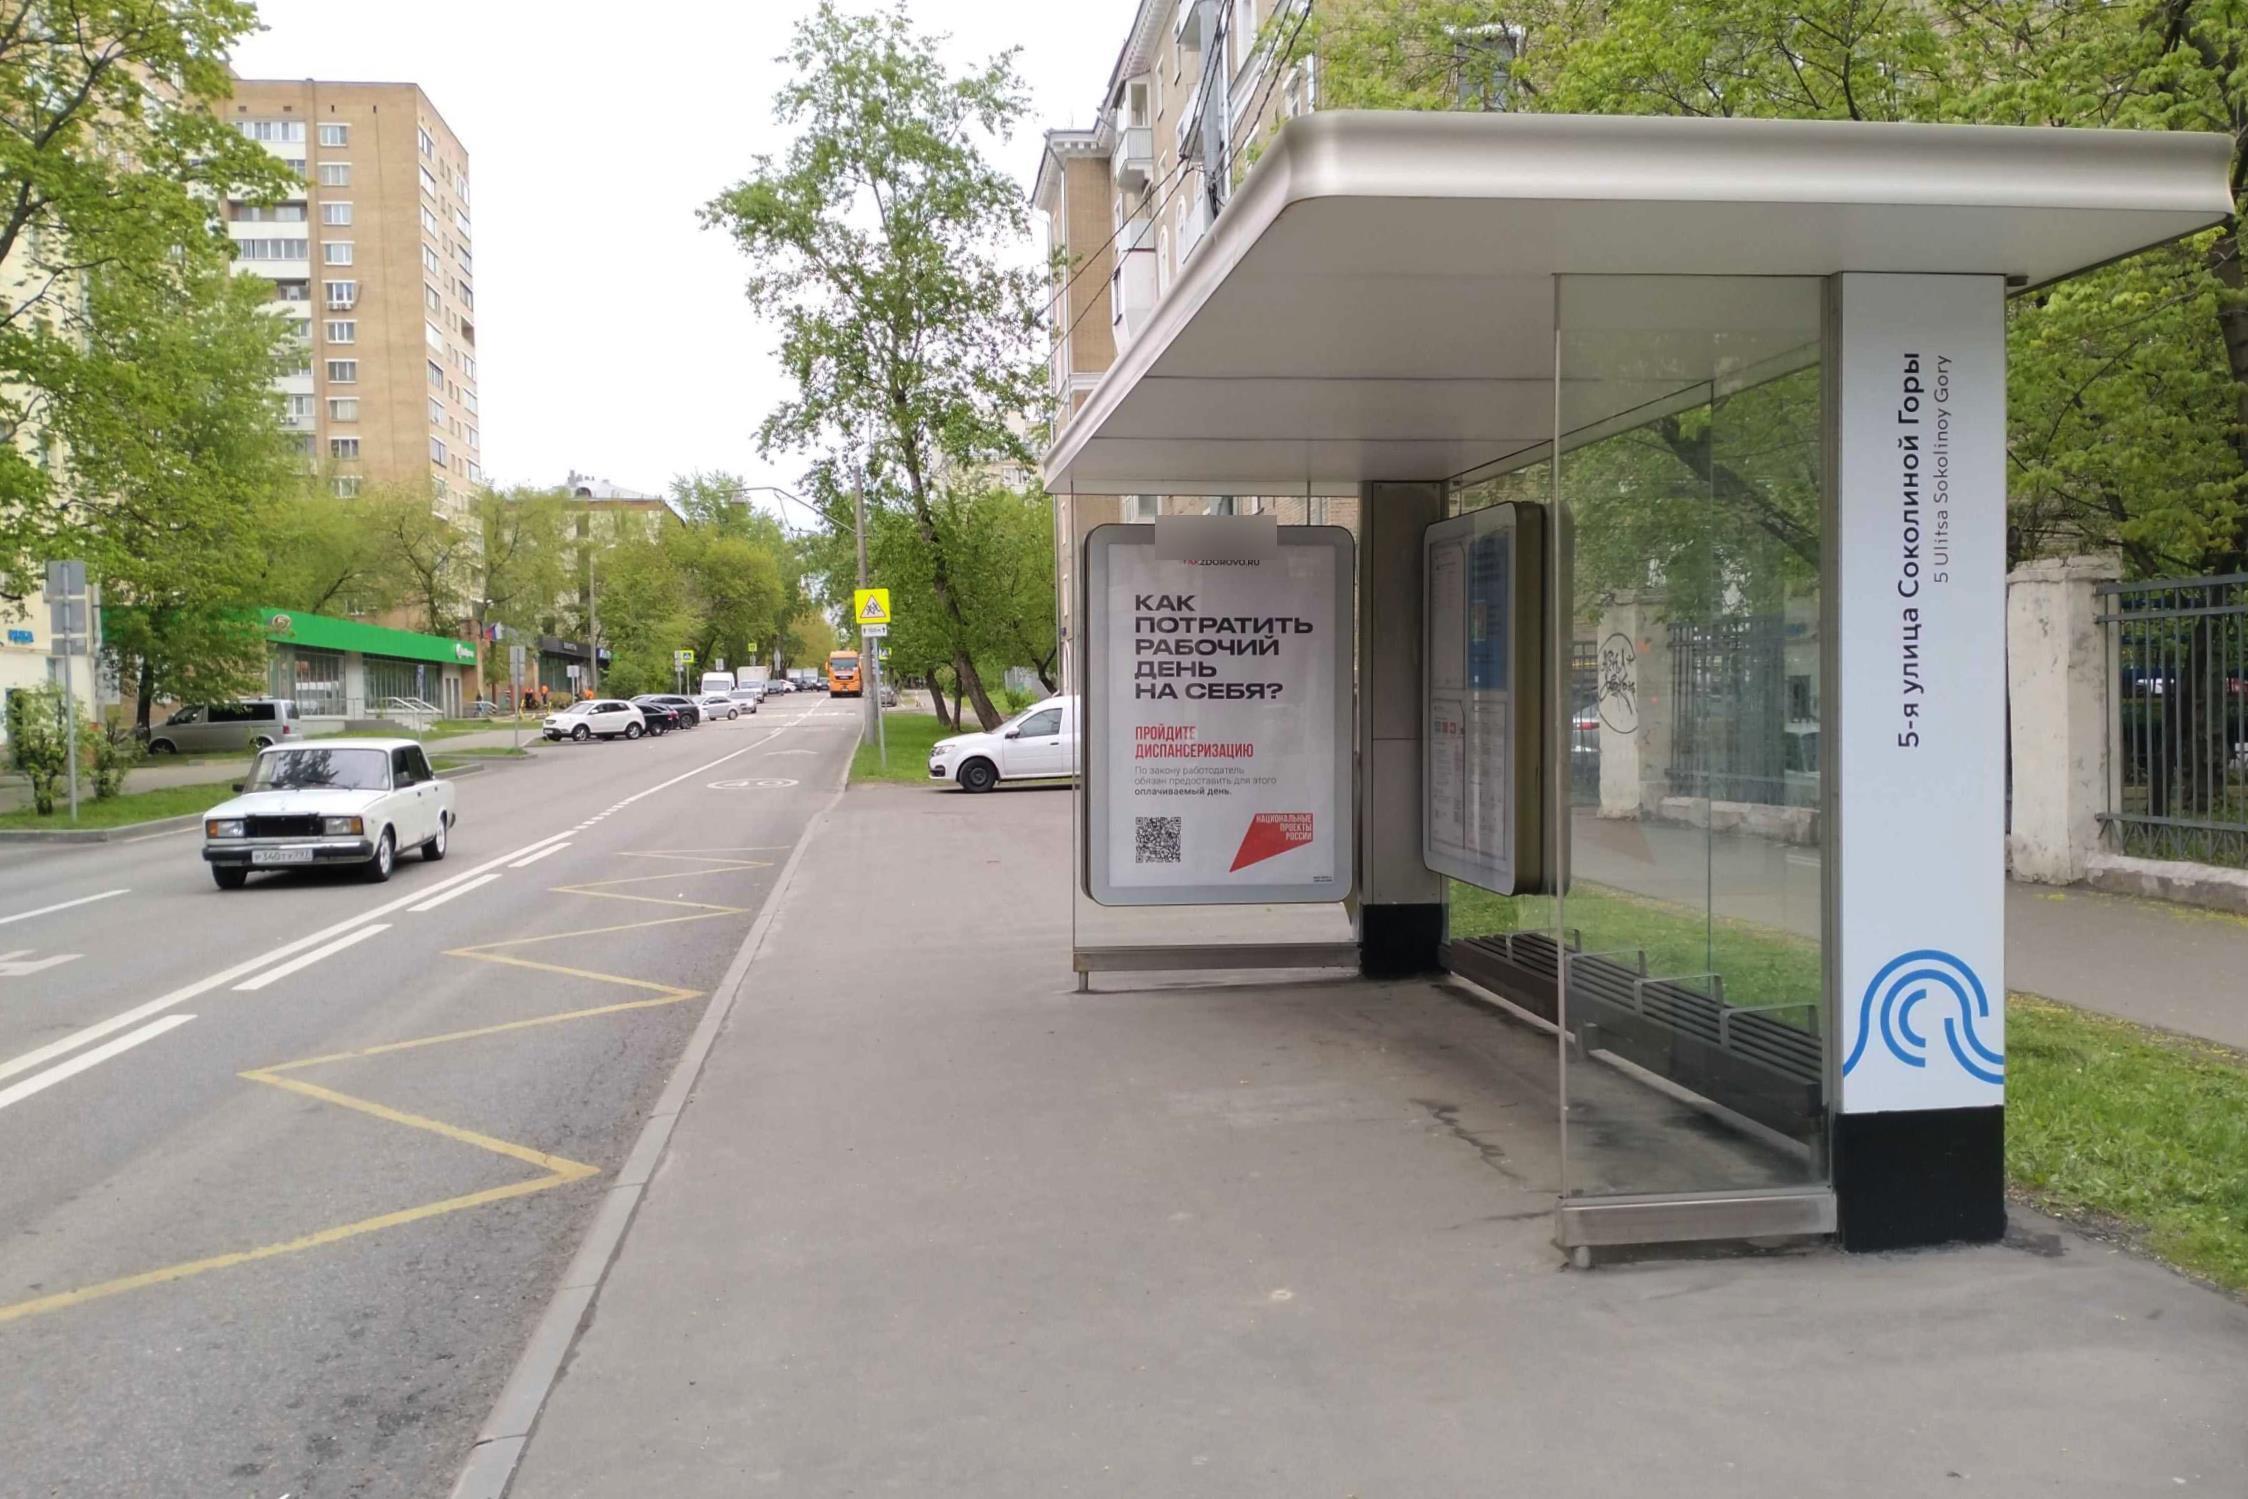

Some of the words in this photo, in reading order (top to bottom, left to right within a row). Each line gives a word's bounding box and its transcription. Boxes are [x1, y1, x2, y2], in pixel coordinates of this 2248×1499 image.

[1933, 354, 1953, 404] Gory
[1897, 353, 1925, 425] Горы
[1932, 407, 1952, 504] Sokolinoy
[1897, 435, 1920, 599] Соколиной
[1932, 509, 1949, 566] Ulitsa
[1933, 571, 1949, 584] 5
[1135, 594, 1196, 612] КАК
[1135, 616, 1314, 634] ПОТРАТИТЬ
[1135, 634, 1280, 656] РАБОЧИЙ
[1902, 607, 1925, 695] улица
[1134, 660, 1218, 680] ДЕНЬ
[1135, 682, 1178, 700] НА
[1184, 682, 1284, 700] СЕБЯ?
[1135, 723, 1196, 741] ПРОЙДИТЕ
[1897, 702, 1920, 748] 5-я
[1135, 743, 1254, 759] ДИСПАНСЕРИЗАЦИЮ
[1149, 768, 1180, 777] закону
[1183, 765, 1244, 777] работодатель
[1134, 777, 1167, 786] обязан
[1170, 777, 1232, 787] предоставить
[1134, 787, 1205, 796] оплачиваемый
[1255, 814, 1312, 823] НАЦИОНАЛЬНЫЕ
[1280, 823, 1312, 832] ПРОЕКТЫ
[1285, 832, 1312, 841] РОССИИ
